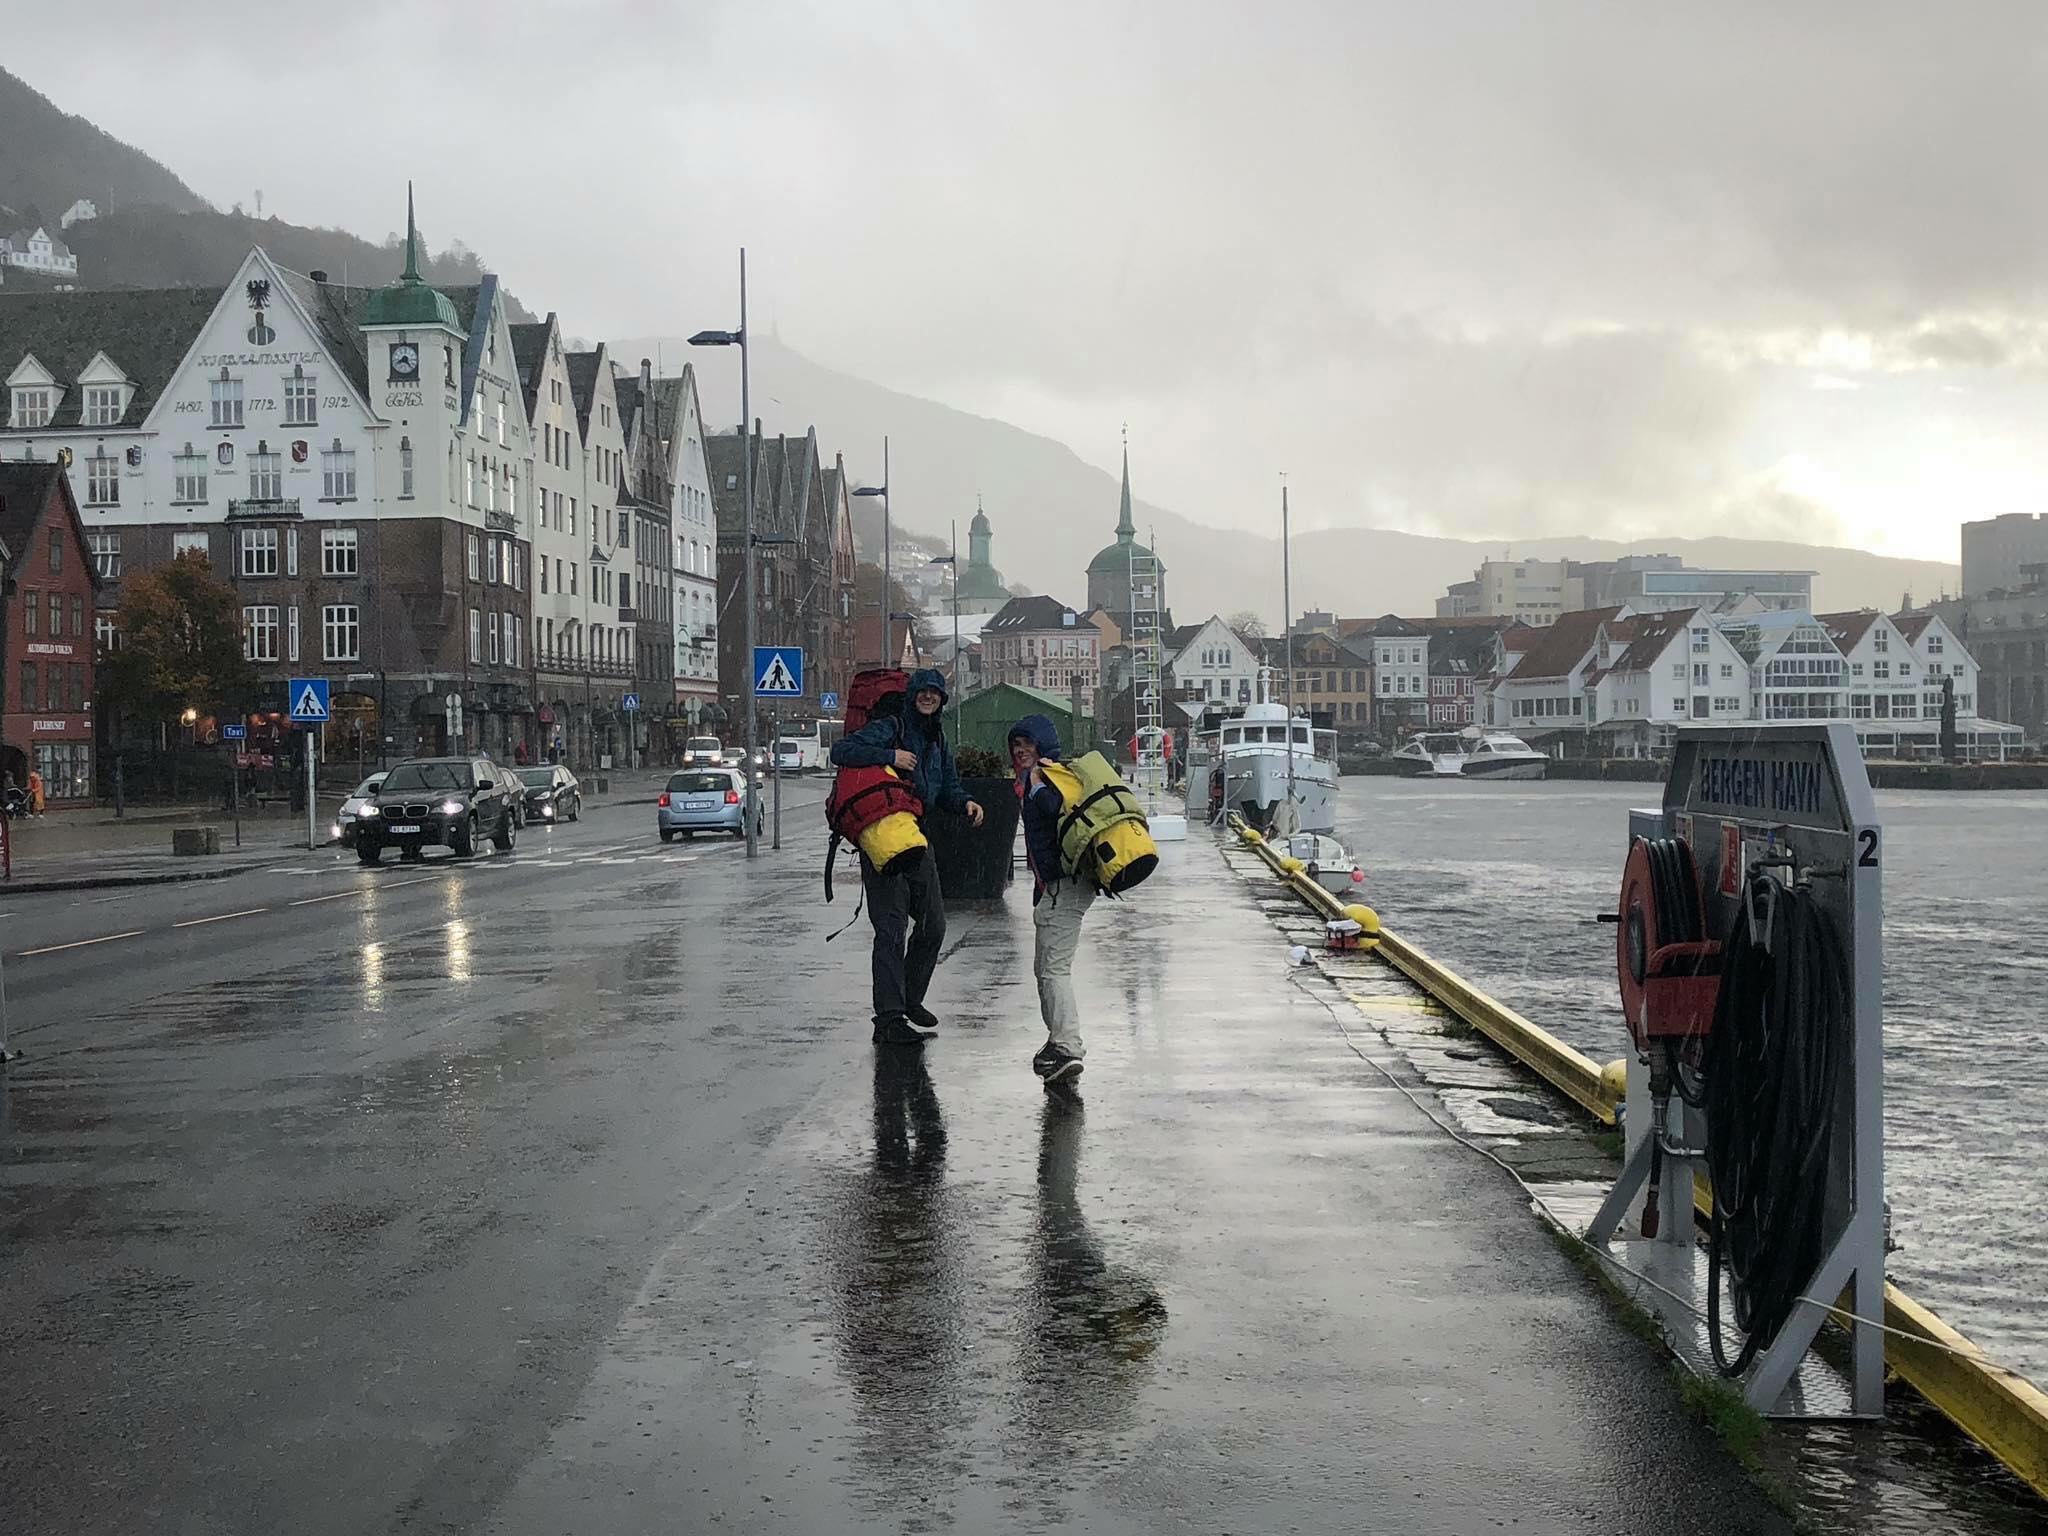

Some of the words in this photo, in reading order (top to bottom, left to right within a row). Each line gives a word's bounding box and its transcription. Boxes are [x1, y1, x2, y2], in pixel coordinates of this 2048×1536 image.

[227, 727, 243, 736] Taxi
[1700, 758, 1766, 808] BERGEN
[1771, 760, 1822, 814] HAVN
[1858, 829, 1879, 867] 2
